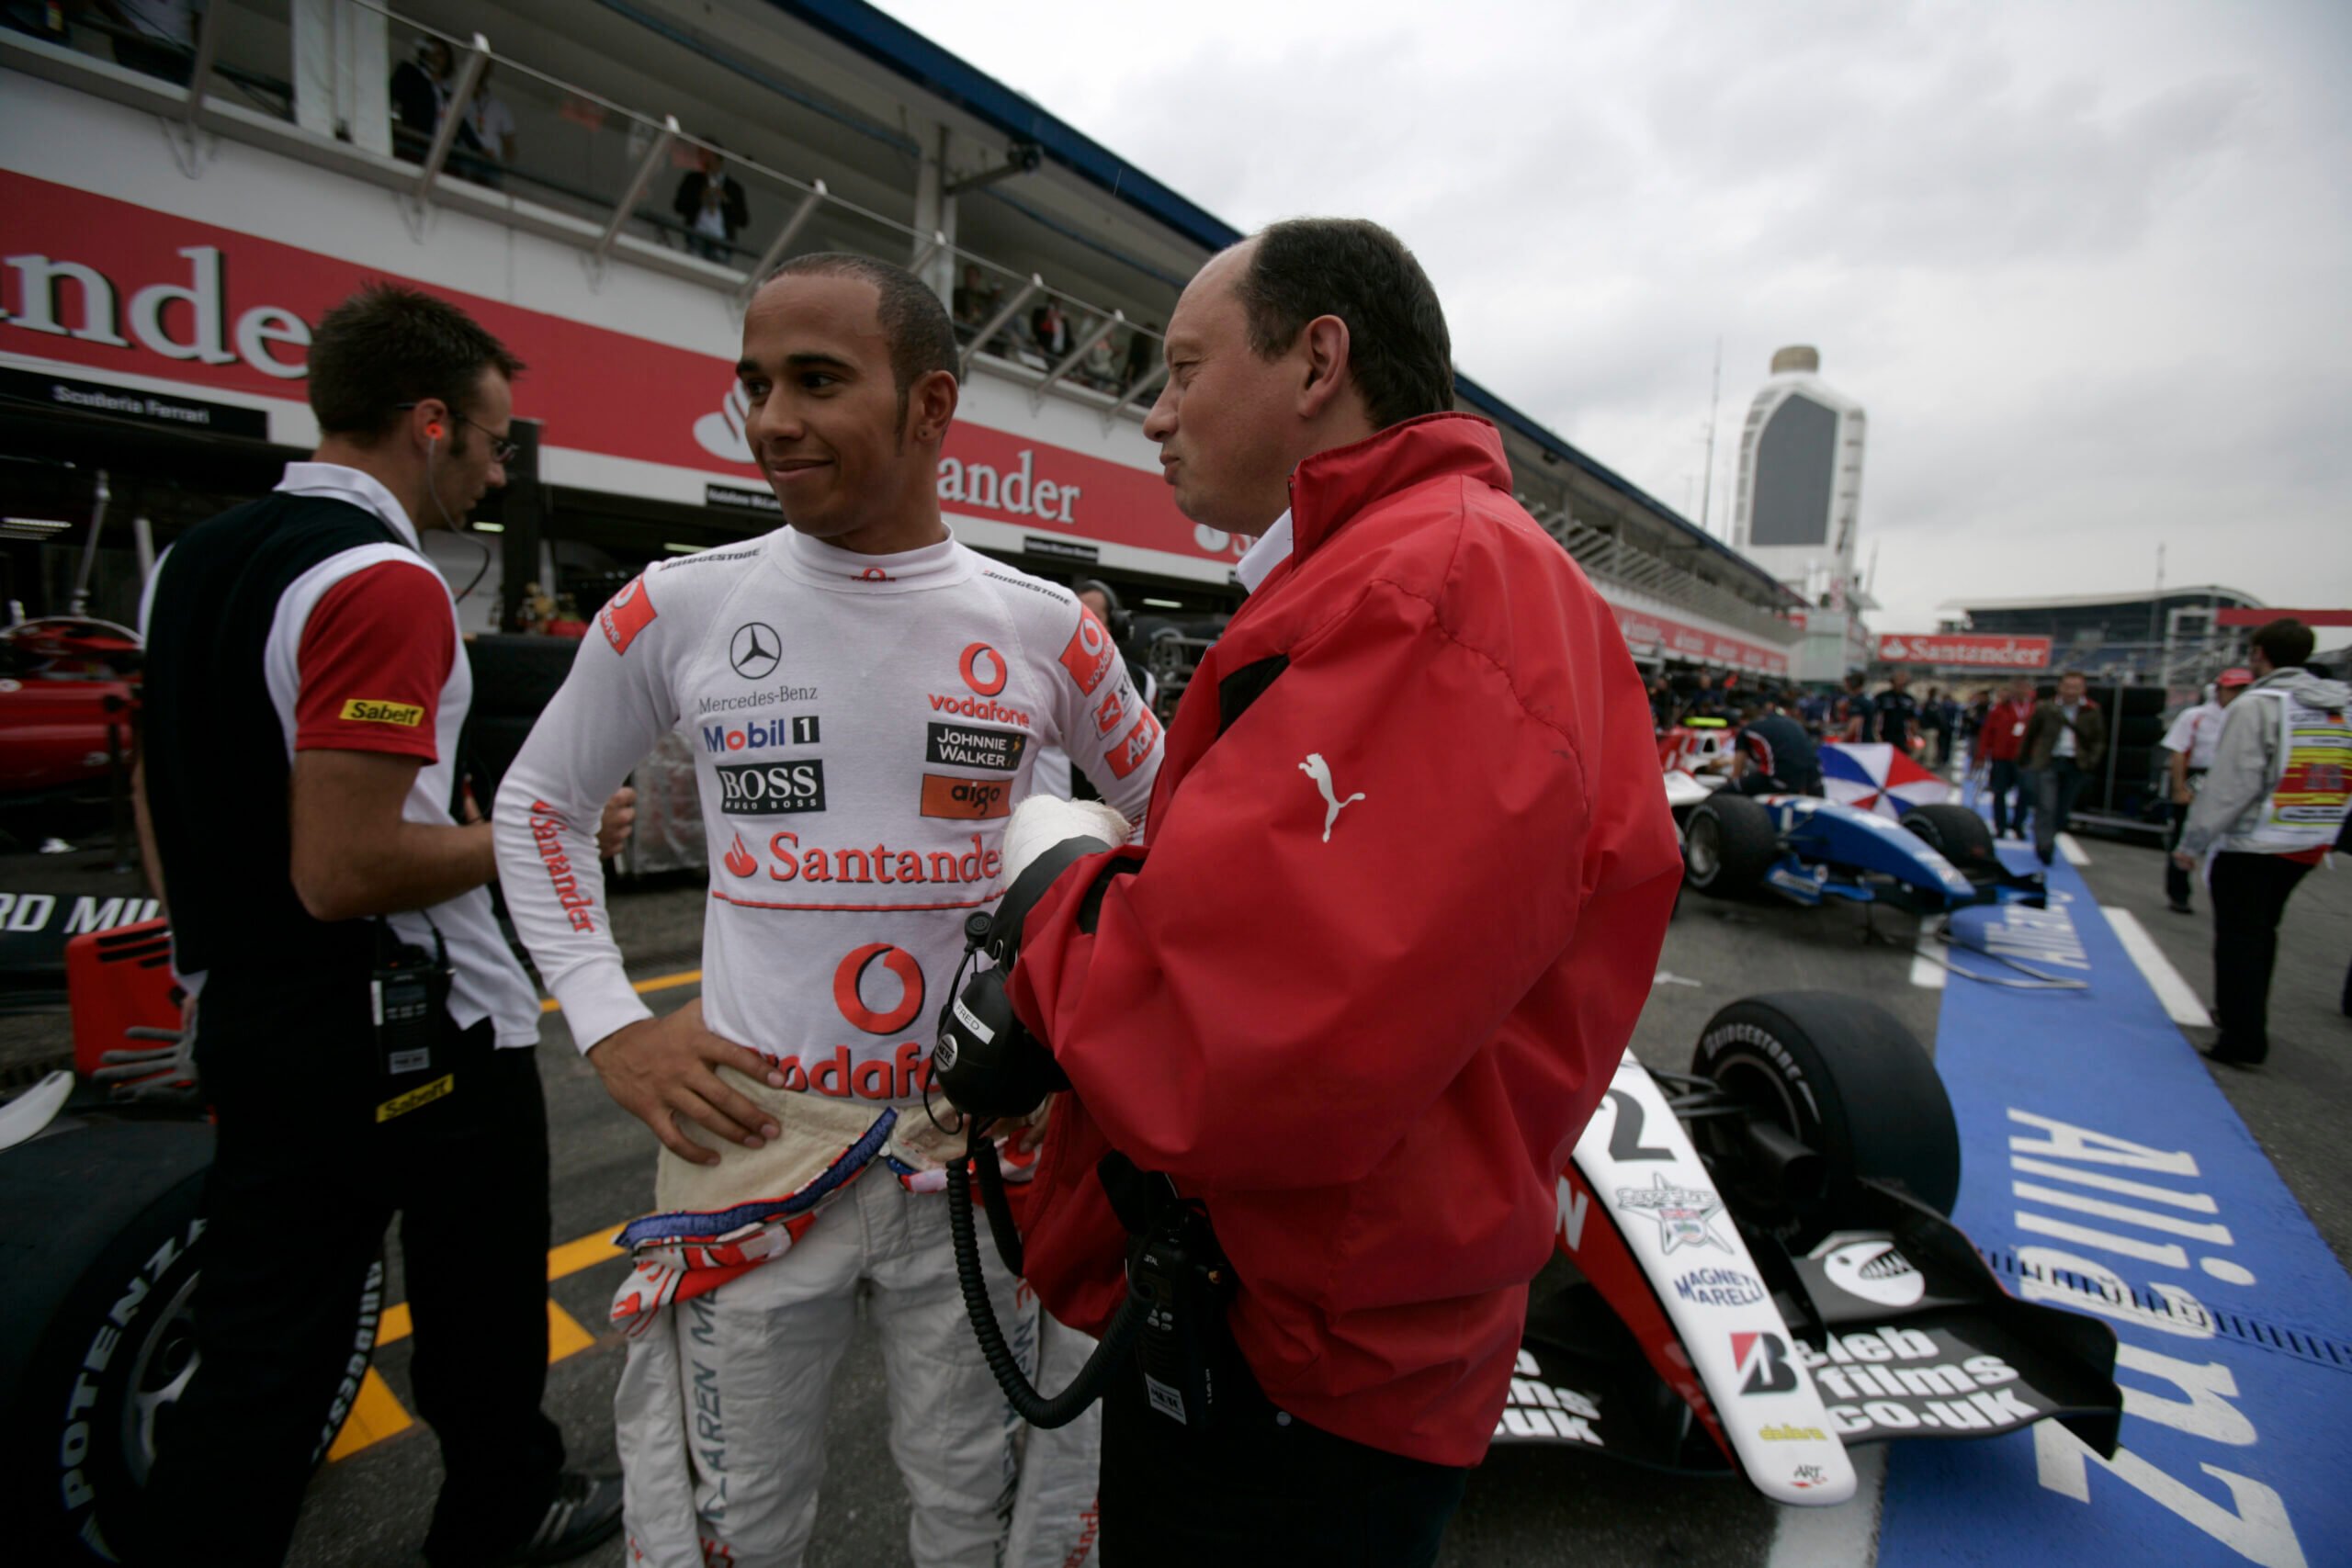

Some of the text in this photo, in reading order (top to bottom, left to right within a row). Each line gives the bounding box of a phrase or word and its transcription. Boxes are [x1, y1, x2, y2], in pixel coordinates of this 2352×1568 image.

[2, 245, 313, 379] nde
[52, 385, 209, 424] Scuderia Ferrari
[937, 449, 1080, 524] ander
[1908, 638, 2042, 666] Santander
[350, 702, 419, 725] Sabelt
[698, 685, 819, 716] Mercedes-Benz
[927, 694, 1030, 728] vodafone
[703, 718, 785, 752] Mobil
[937, 728, 1008, 751] JOHNNIE
[938, 744, 1006, 767] WALKER
[719, 766, 818, 800] BOSS
[951, 782, 1001, 816] aigo
[725, 798, 818, 810] HUGO BOSS
[769, 831, 1002, 884] Santande
[530, 817, 594, 933] Santander
[956, 1004, 980, 1031] FRED
[1703, 1023, 1803, 1081] BRIDGESTONE
[1816, 1354, 2019, 1399] films
[1825, 1387, 2041, 1435] co.uk
